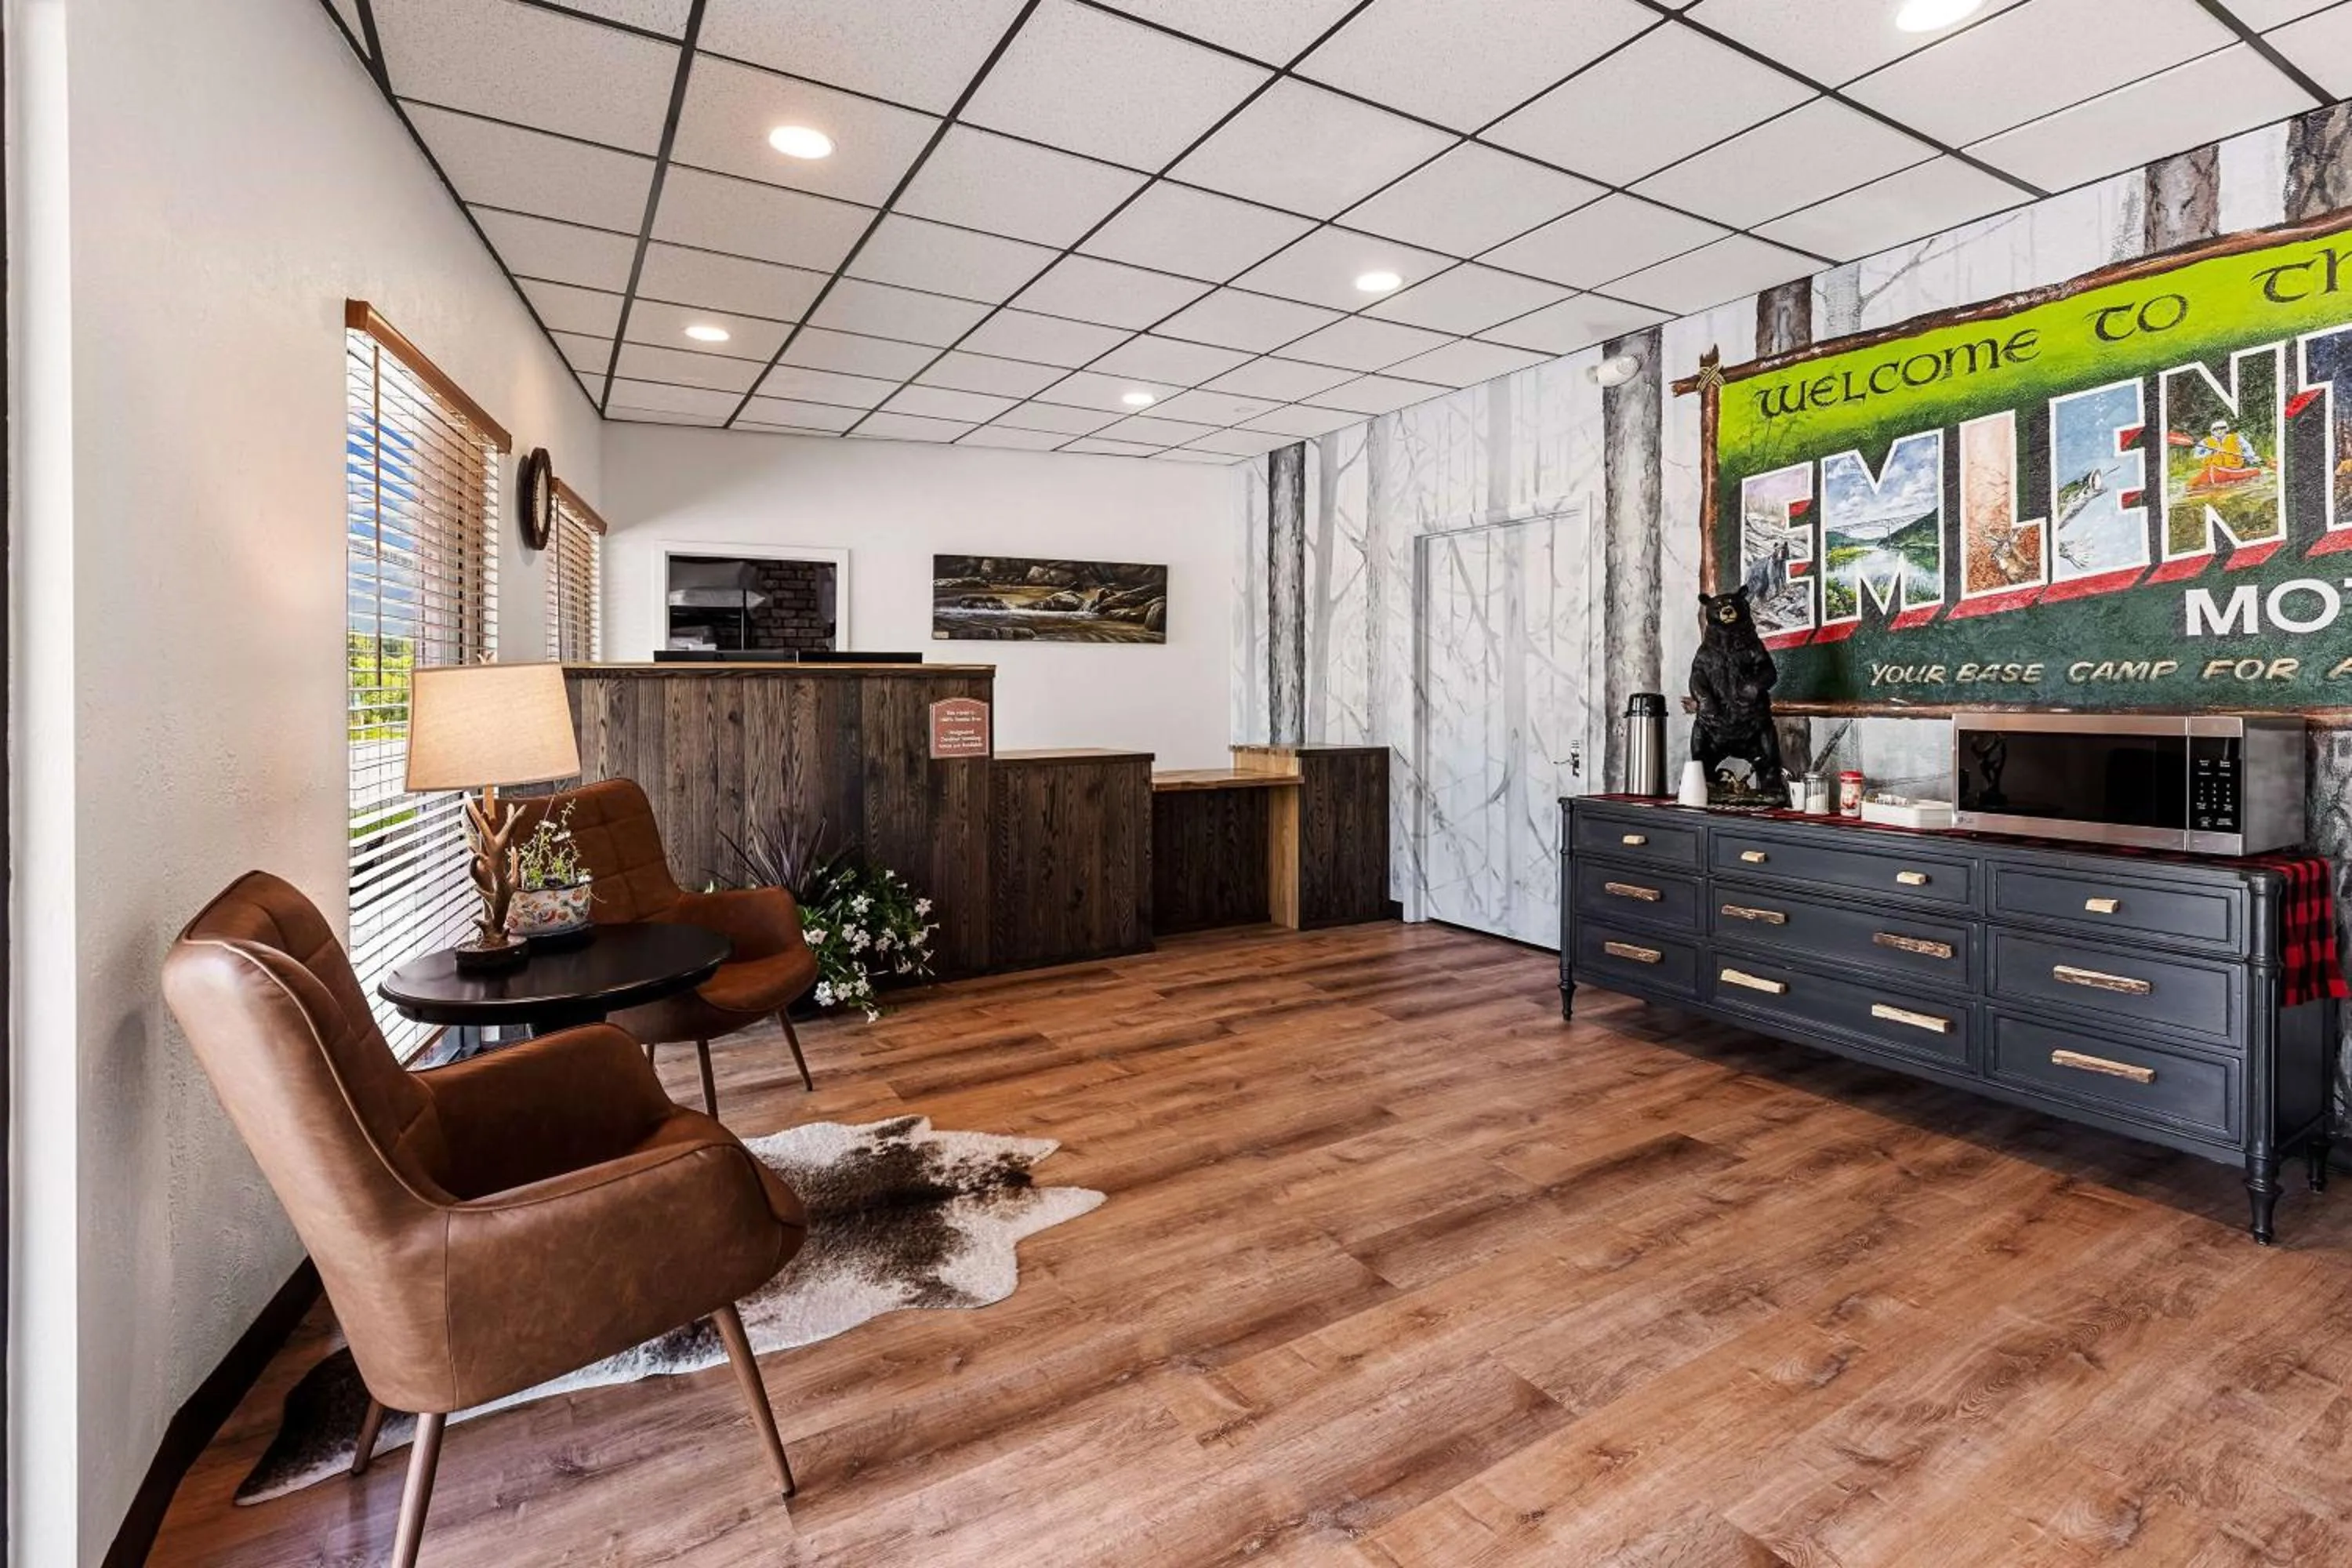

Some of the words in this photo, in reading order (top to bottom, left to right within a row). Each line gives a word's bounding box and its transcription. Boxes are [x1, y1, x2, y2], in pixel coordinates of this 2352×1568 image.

[2184, 577, 2352, 636] MO
[1870, 662, 1947, 687] YOUR
[1955, 661, 2045, 684] BASE
[2067, 660, 2179, 684] CAMP
[2202, 657, 2299, 681] FOR
